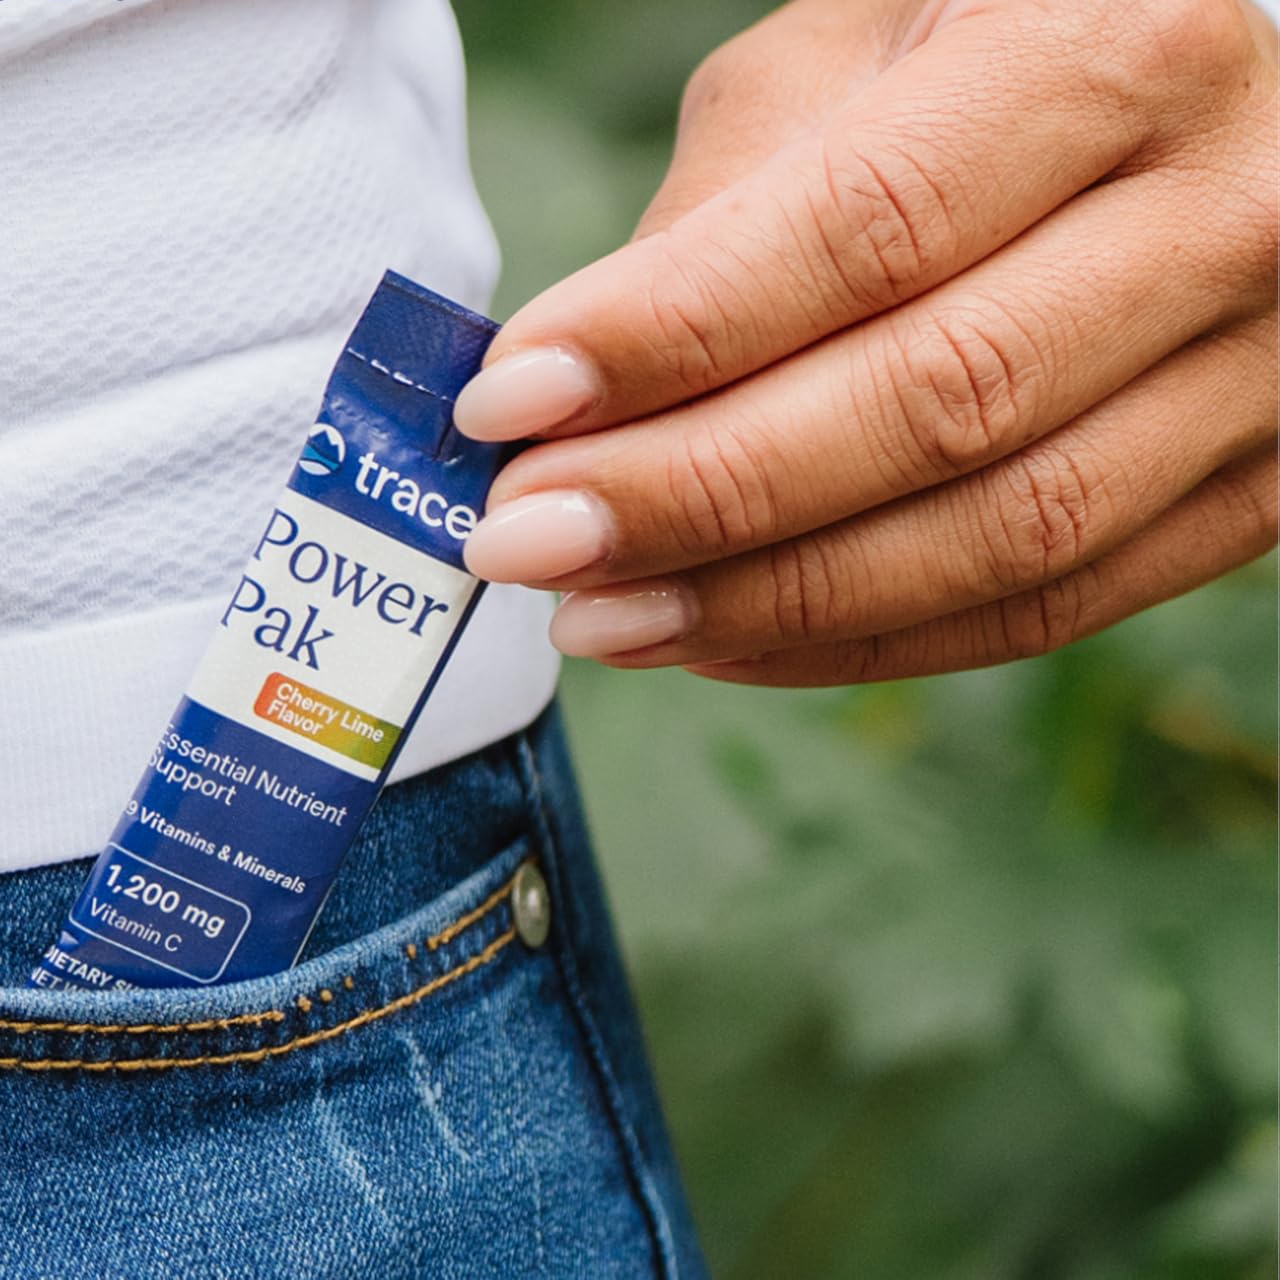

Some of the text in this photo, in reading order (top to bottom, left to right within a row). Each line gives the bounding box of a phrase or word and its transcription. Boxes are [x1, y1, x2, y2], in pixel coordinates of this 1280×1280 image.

[354, 452, 477, 540] trace
[253, 508, 449, 637] Power
[221, 574, 335, 671] Pak
[267, 700, 325, 736] Flavor
[275, 682, 385, 744] Cherry Lime
[255, 770, 349, 827] Nutrient
[140, 806, 215, 856] Vitamins
[217, 845, 231, 863] &
[233, 851, 307, 895] Minerals
[90, 896, 183, 953] Vitamin C
[106, 863, 226, 939] 1,200 mg
